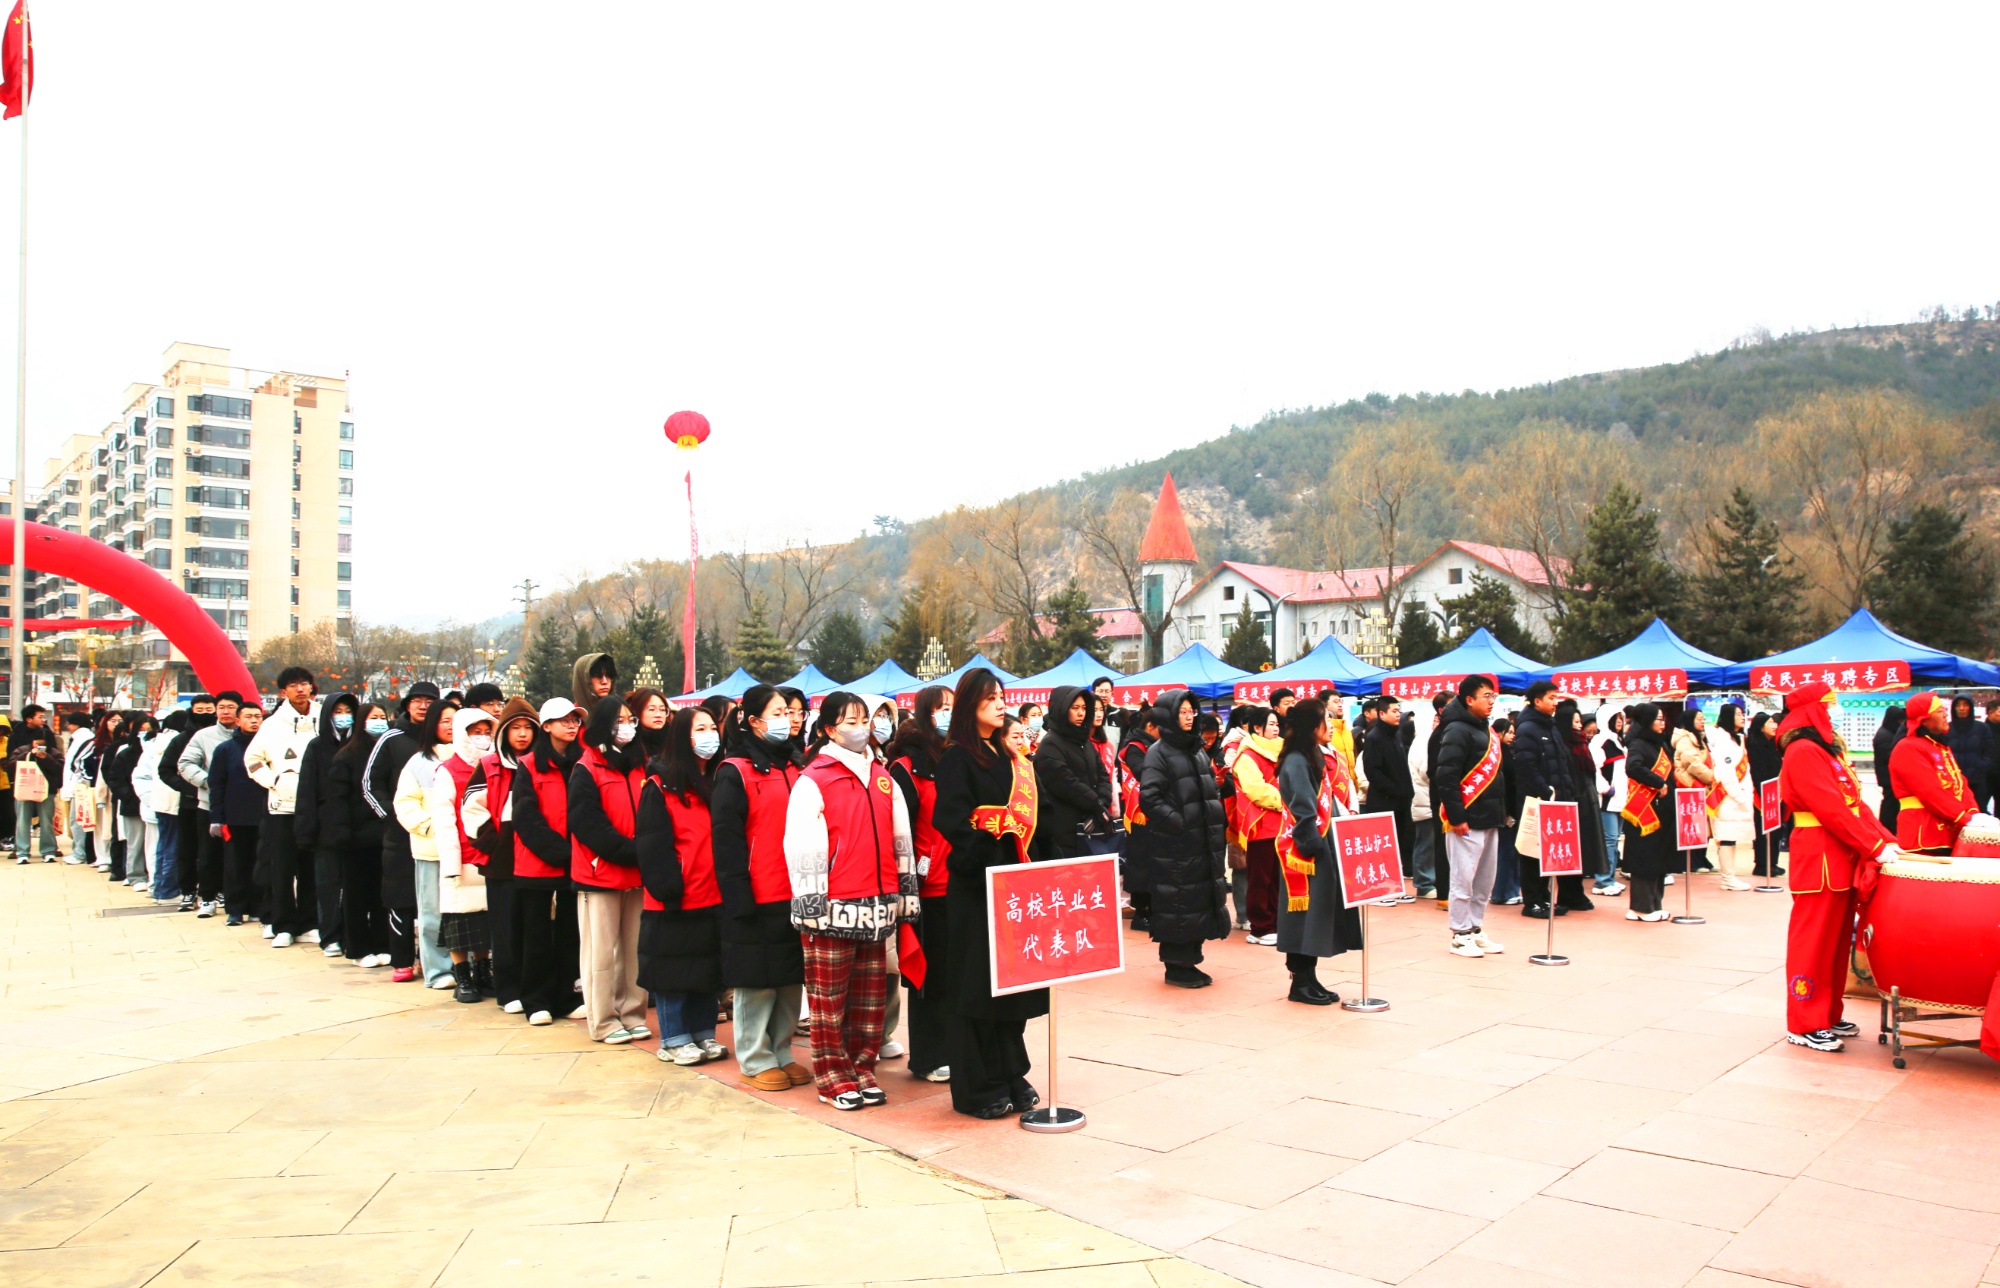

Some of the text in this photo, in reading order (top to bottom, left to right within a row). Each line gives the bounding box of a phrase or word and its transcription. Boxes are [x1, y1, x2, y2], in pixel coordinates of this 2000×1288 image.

[1557, 674, 1679, 694] 高校毕业生招聘专区
[1758, 666, 1901, 689] 农民工招聘专区
[1545, 817, 1573, 836] 农民工
[1344, 834, 1393, 857] 吕梁山护工
[1549, 842, 1573, 860] 代表队
[1355, 861, 1391, 886] 代表队
[1006, 884, 1106, 923] 高校毕业生
[1022, 927, 1095, 961] 代表队
